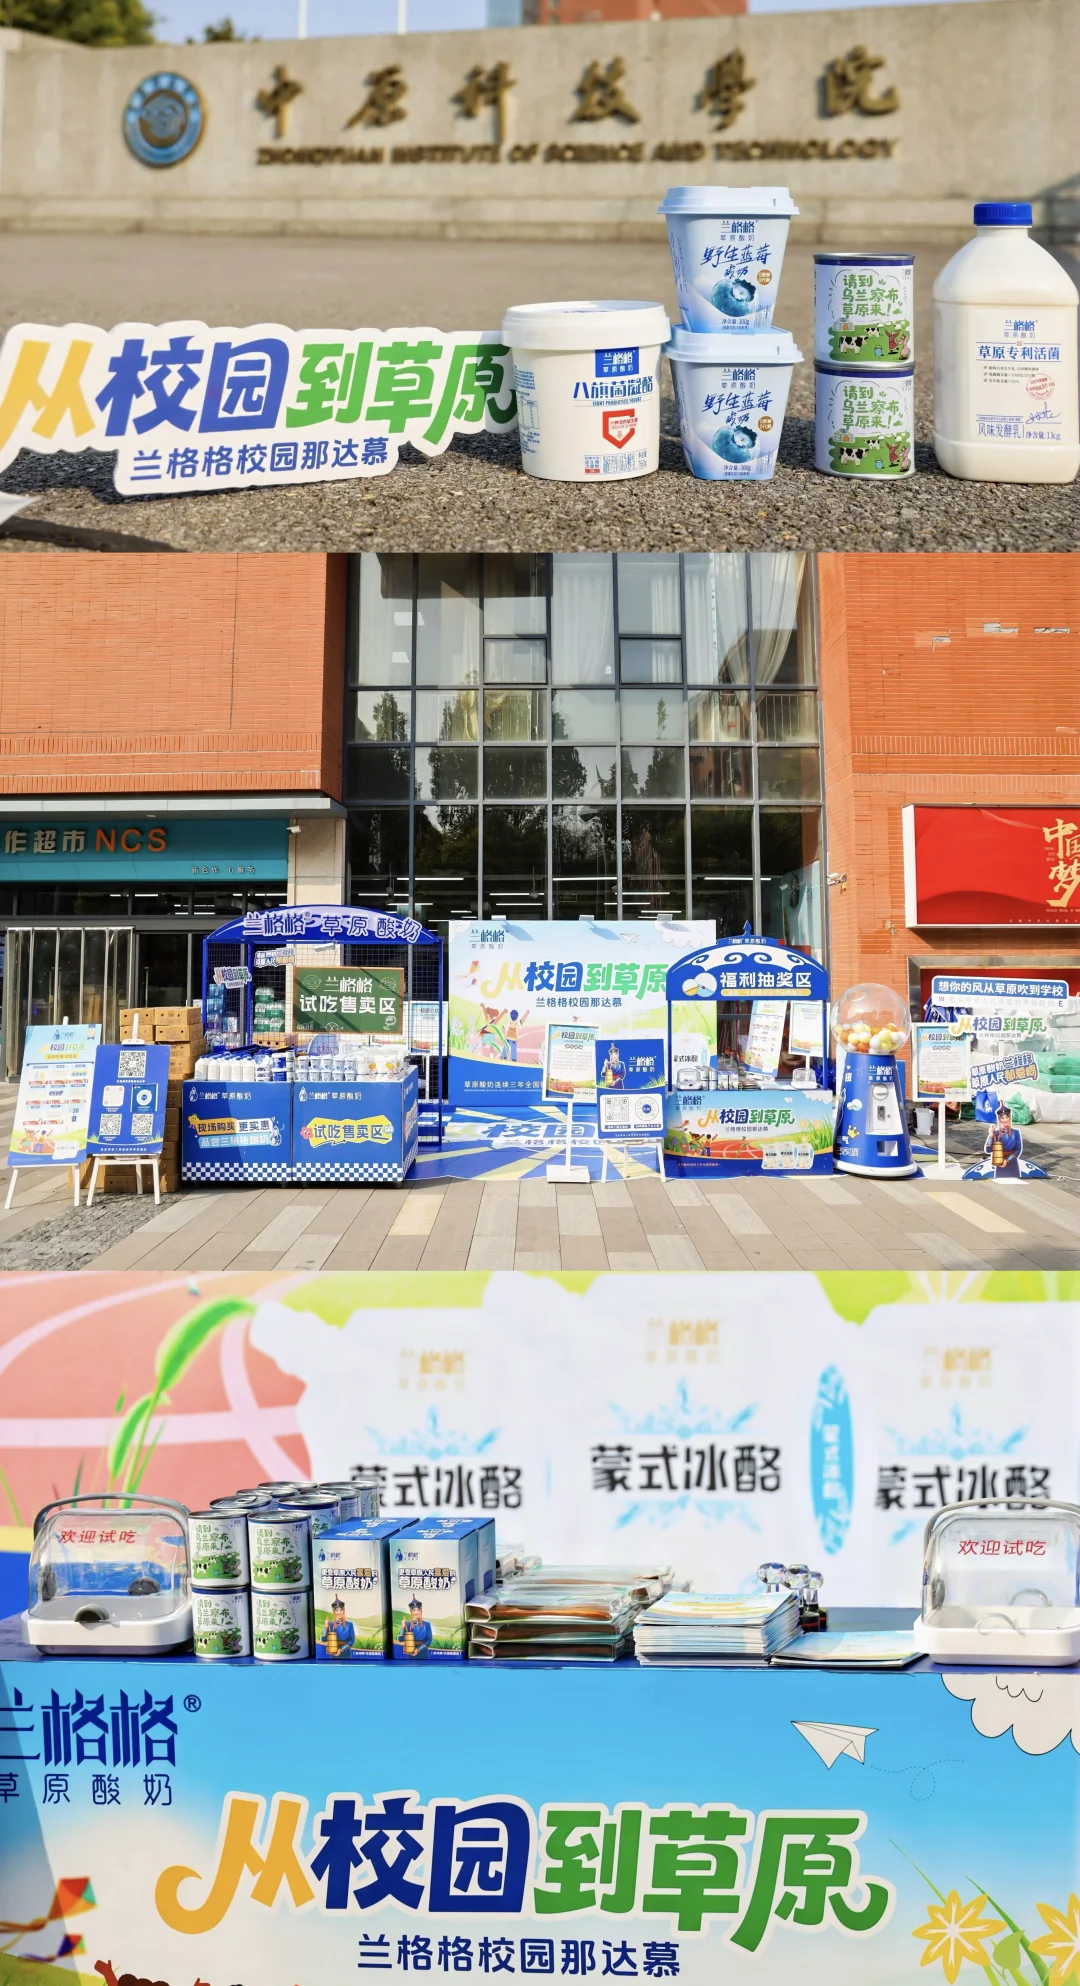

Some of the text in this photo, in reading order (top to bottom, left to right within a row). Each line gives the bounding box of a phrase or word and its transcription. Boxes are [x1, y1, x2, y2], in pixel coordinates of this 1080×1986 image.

[257, 138, 897, 165] ZHONGYUAN INSTITUTE OF SCIENCE AND TECHNOLOGY
[700, 243, 772, 268] 野生蓝莓
[724, 264, 749, 279] 酸奶
[843, 274, 873, 288] 请到
[842, 288, 899, 303] 乌兰察布
[842, 303, 891, 319] 草原来!
[978, 345, 1060, 361] 草原专利活菌
[0, 335, 517, 451] 从校园到草原
[573, 376, 653, 399] 八旗菌凝酪
[843, 385, 874, 399] 请到
[702, 390, 773, 415] 野生蓝莓
[842, 399, 899, 414] 乌兰察布
[726, 411, 749, 426] 酸奶
[842, 414, 892, 431] 草原来!
[978, 422, 1021, 439] 风味发酵乳
[130, 436, 389, 481] 兰格格校园那达慕
[4, 828, 167, 854] 作超市 NCS
[319, 914, 423, 943] 草原酸奶
[469, 929, 505, 943] 兰格格
[324, 976, 373, 994] 兰格格
[480, 960, 669, 1000] 从校园到草原
[720, 971, 812, 988] 福利抽奖区
[938, 981, 1064, 997] 想你的风从草原吹到学校
[300, 995, 396, 1015] 试吃售卖区
[536, 997, 623, 1008] 兰格格校园那达慕
[951, 1016, 1047, 1036] 从校园到草原
[629, 1055, 655, 1067] 兰格格
[697, 1108, 796, 1128] 从校园到草原
[198, 1120, 270, 1133] 现场购买 更实惠
[314, 1124, 390, 1140] 试吃售卖区
[201, 1135, 269, 1147] 品尝兰格格酸奶
[590, 1443, 781, 1493] 蒙式冰酪
[875, 1463, 1052, 1511] 蒙式冰酪
[58, 1529, 137, 1544] 欢迎试吃
[195, 1523, 212, 1534] 请到
[256, 1528, 273, 1538] 请到
[195, 1532, 230, 1543] 乌兰察布
[256, 1537, 291, 1548] 乌兰察布
[957, 1539, 1047, 1556] 欢迎试吃
[321, 1576, 373, 1590] 草原酸奶
[398, 1576, 451, 1590] 草原酸奶
[196, 1598, 212, 1609] 请到
[196, 1608, 230, 1619] 乌兰察布
[255, 1607, 288, 1618] 乌兰察布
[0, 1772, 172, 1806] 草原酸奶
[155, 1796, 888, 1953] 从校园到草原
[358, 1933, 680, 1977] 兰格格校园那达慕
